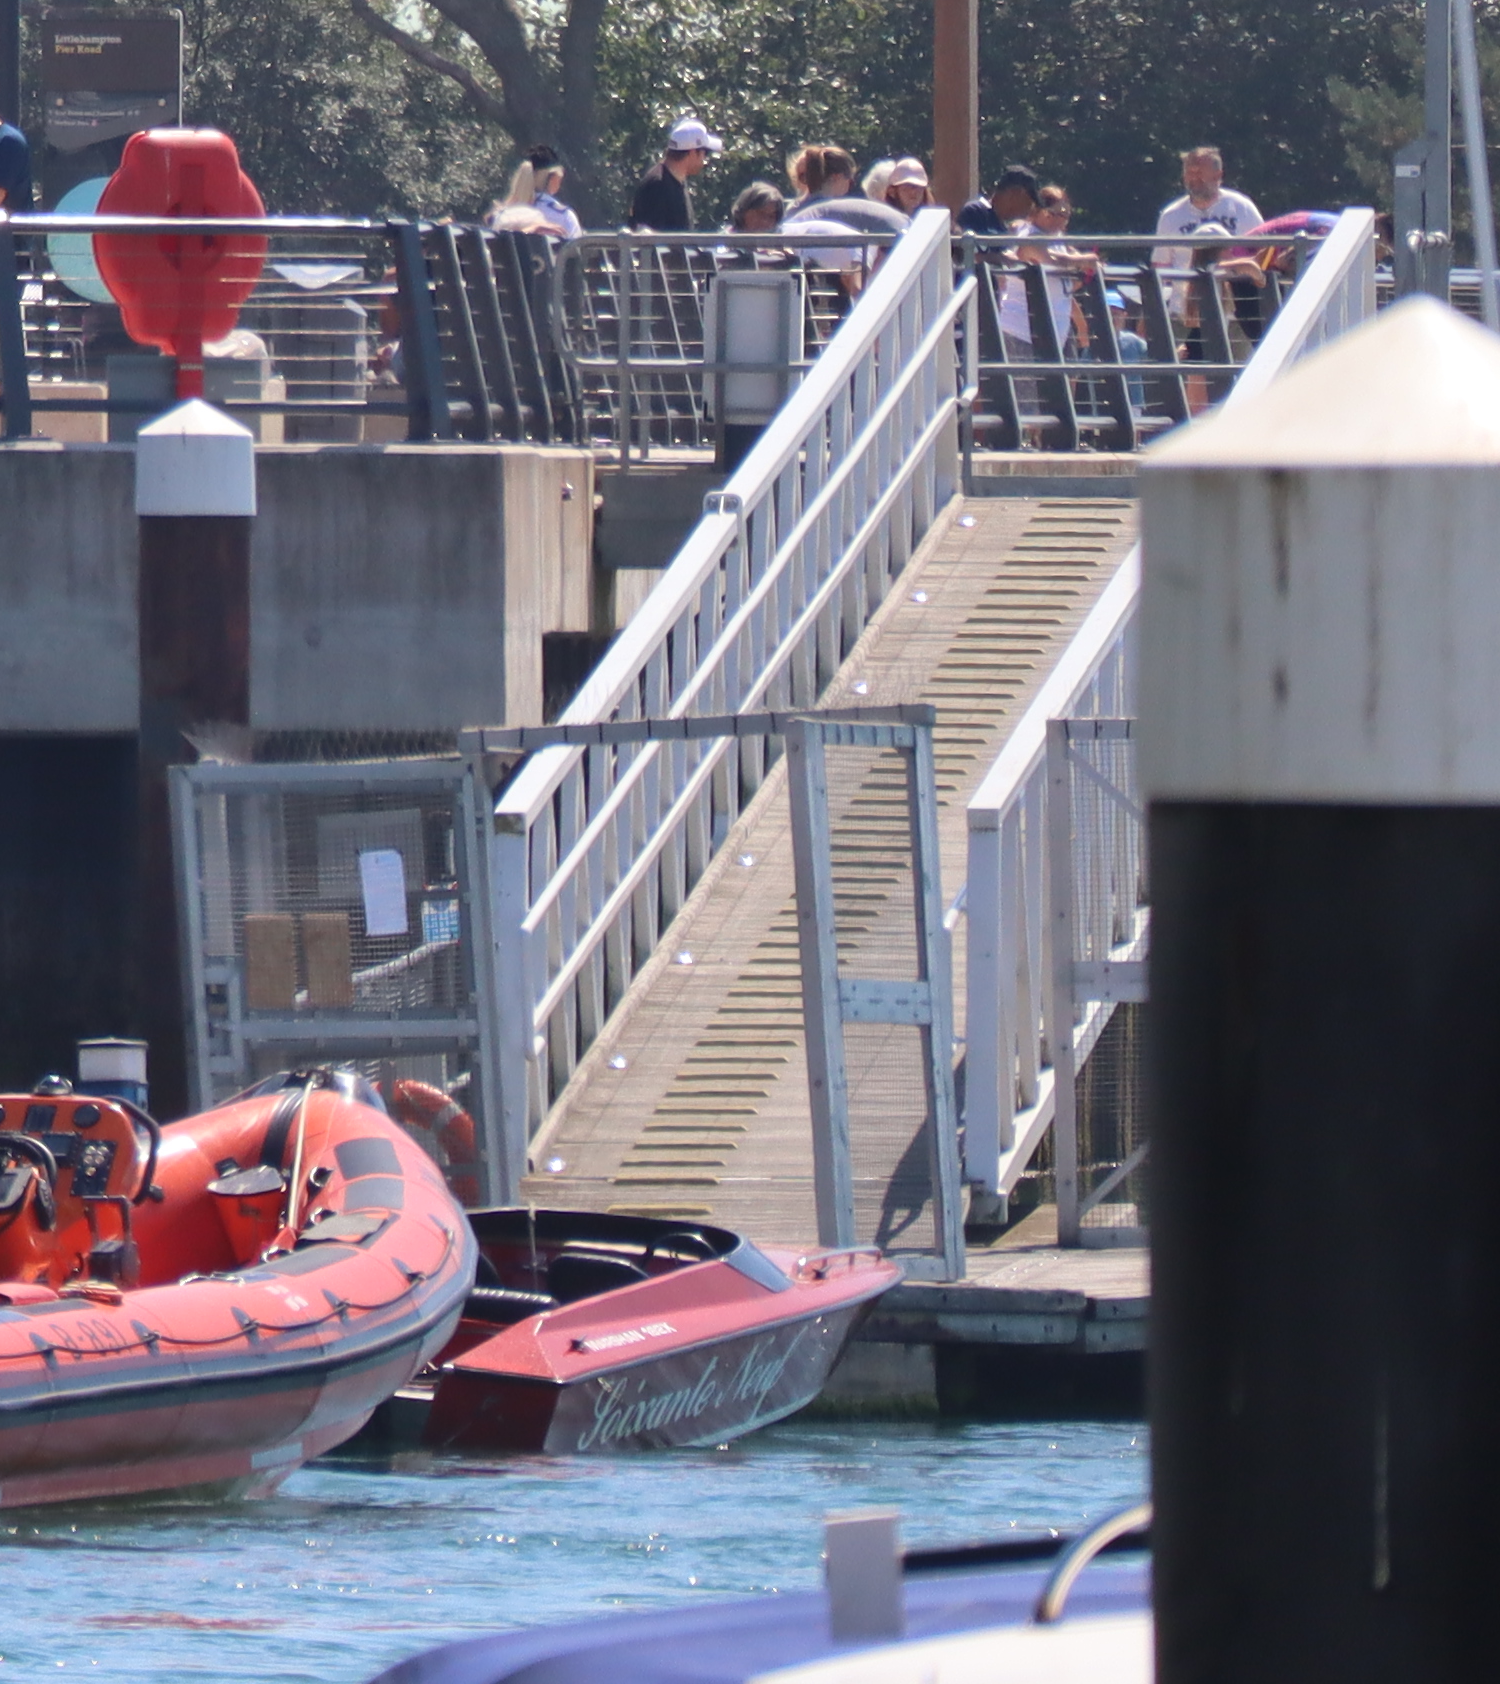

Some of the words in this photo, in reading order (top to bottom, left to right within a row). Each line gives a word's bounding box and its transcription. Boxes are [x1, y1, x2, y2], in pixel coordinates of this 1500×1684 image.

[54, 34, 122, 46] Littlehampton
[54, 45, 75, 54] Pier
[76, 45, 102, 54] Road
